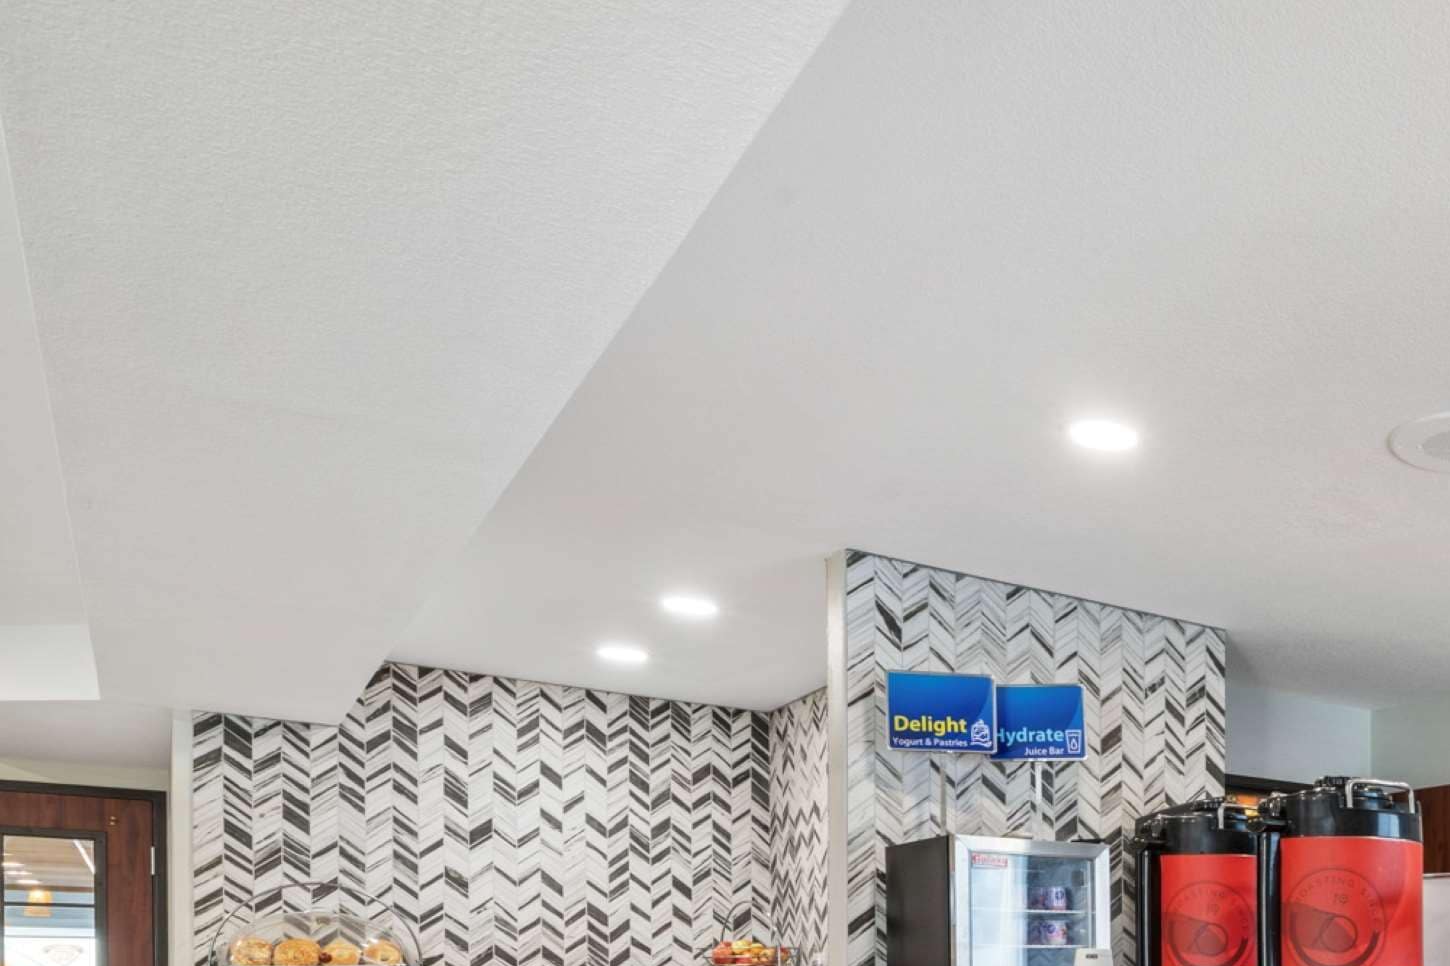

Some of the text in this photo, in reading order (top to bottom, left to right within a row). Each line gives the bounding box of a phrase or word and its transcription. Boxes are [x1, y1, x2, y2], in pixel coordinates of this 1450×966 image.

[894, 714, 967, 737] Delight
[892, 736, 968, 748] Yogurt & Pastries
[1024, 746, 1064, 756] Juice Bar
